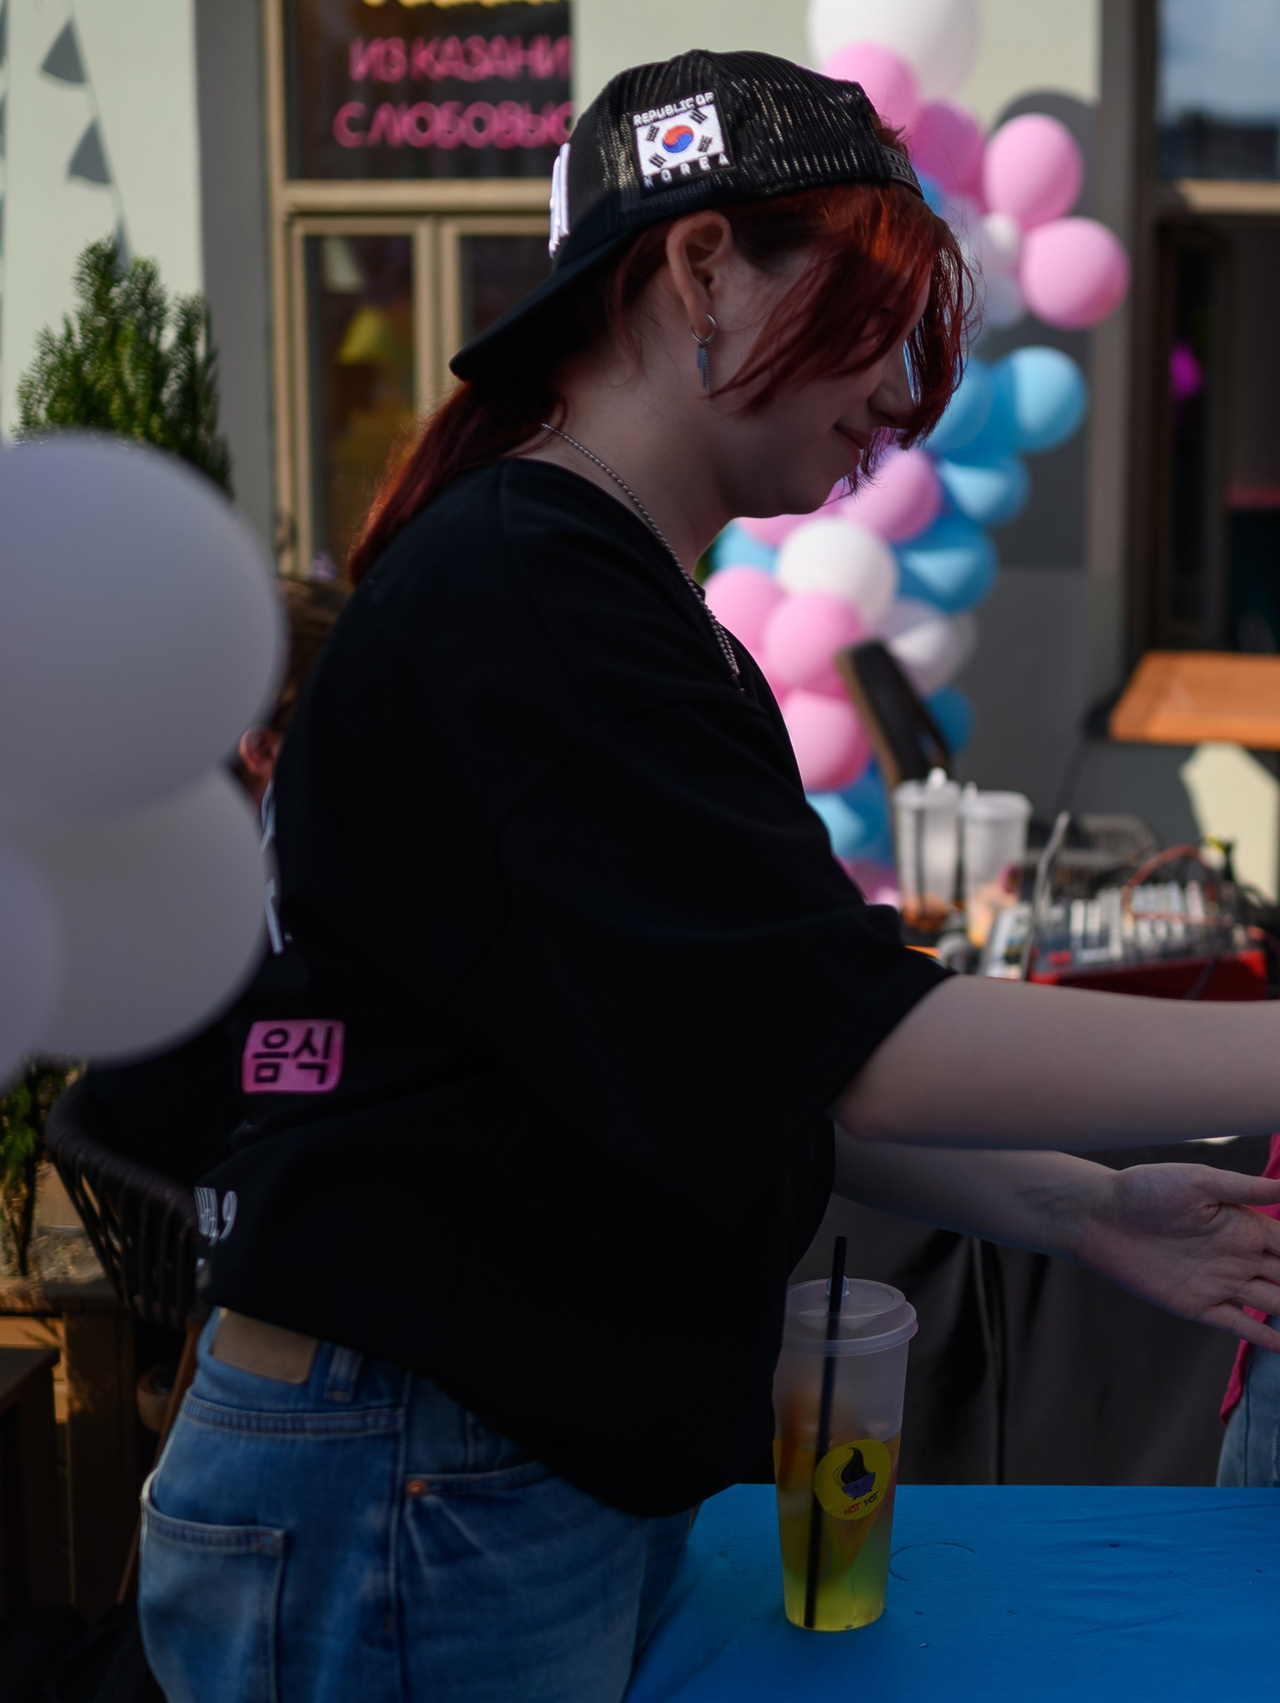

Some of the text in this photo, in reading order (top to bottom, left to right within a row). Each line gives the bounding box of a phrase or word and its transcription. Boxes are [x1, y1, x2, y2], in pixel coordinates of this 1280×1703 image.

[349, 36, 407, 83] ИЗ
[632, 91, 714, 127] REPUBLIC OF
[643, 153, 730, 190] KOREA
[252, 1025, 334, 1085] 음식
[843, 1489, 880, 1516] HOT POT
